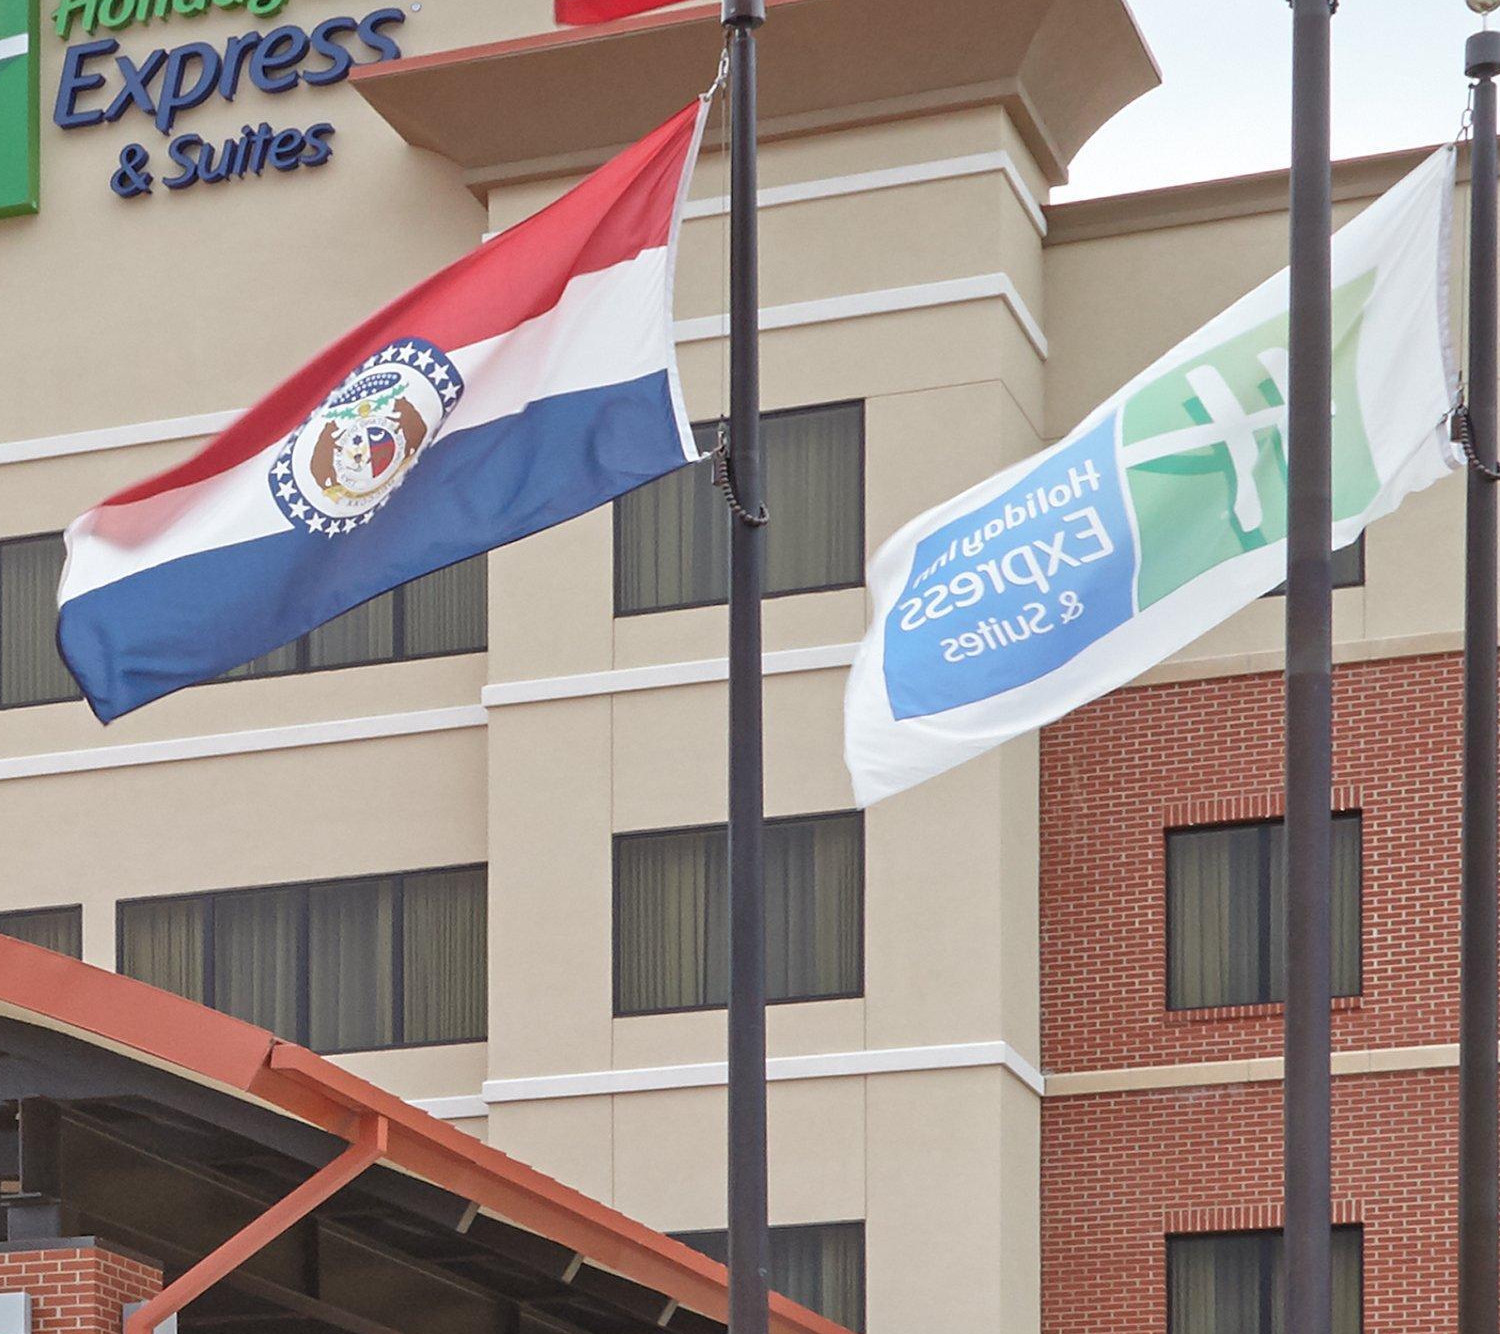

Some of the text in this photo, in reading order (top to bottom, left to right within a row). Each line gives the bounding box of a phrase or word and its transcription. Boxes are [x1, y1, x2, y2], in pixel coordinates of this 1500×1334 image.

[53, 8, 406, 136] Express
[110, 122, 336, 199] & Suites
